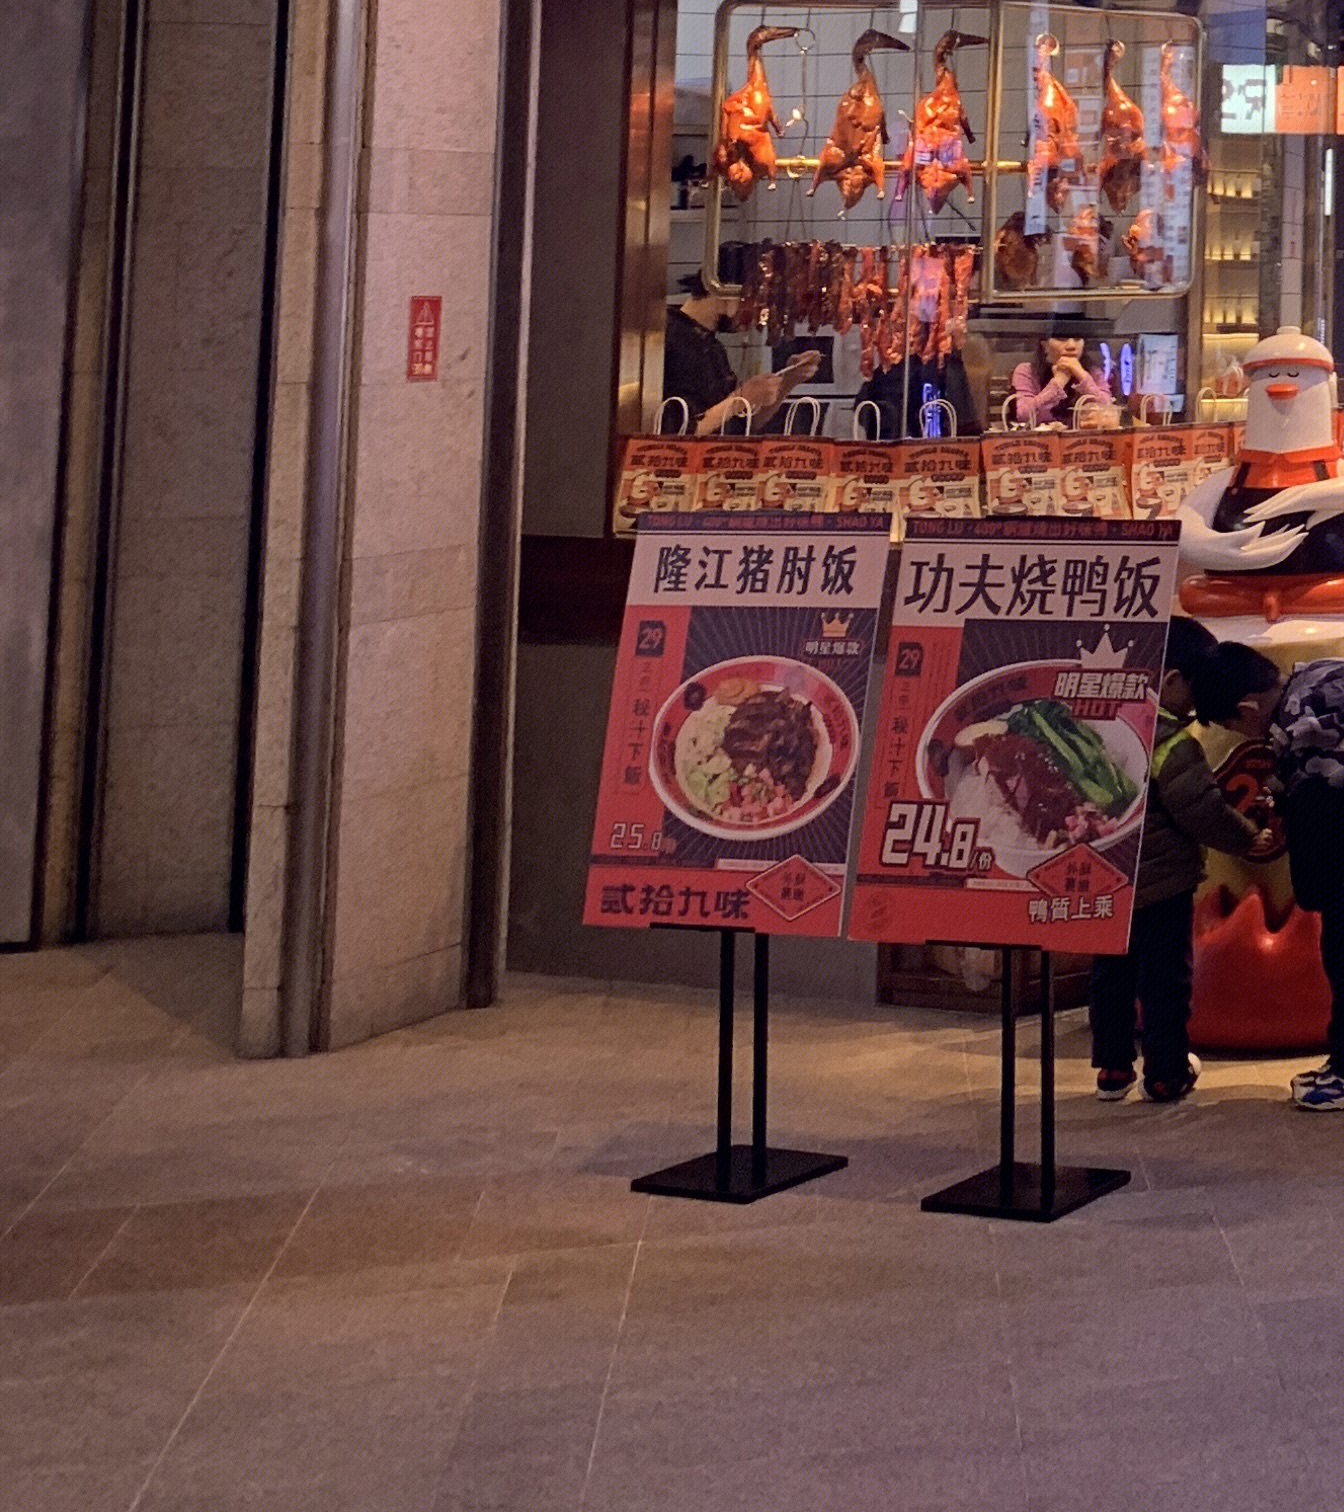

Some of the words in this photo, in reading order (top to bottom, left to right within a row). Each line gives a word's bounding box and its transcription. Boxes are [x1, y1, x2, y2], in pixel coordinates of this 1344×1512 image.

[653, 543, 858, 596] 隆江猪肘饭
[903, 552, 1163, 619] 功夫烧鸭饭
[638, 627, 661, 650] 29
[898, 651, 921, 671] 29
[1053, 670, 1149, 700] 明星爆款
[1074, 699, 1120, 718] HOT
[609, 822, 662, 850] 25.8
[601, 883, 751, 919] 贰拾九味
[1028, 894, 1114, 923] 鴨質上乘
